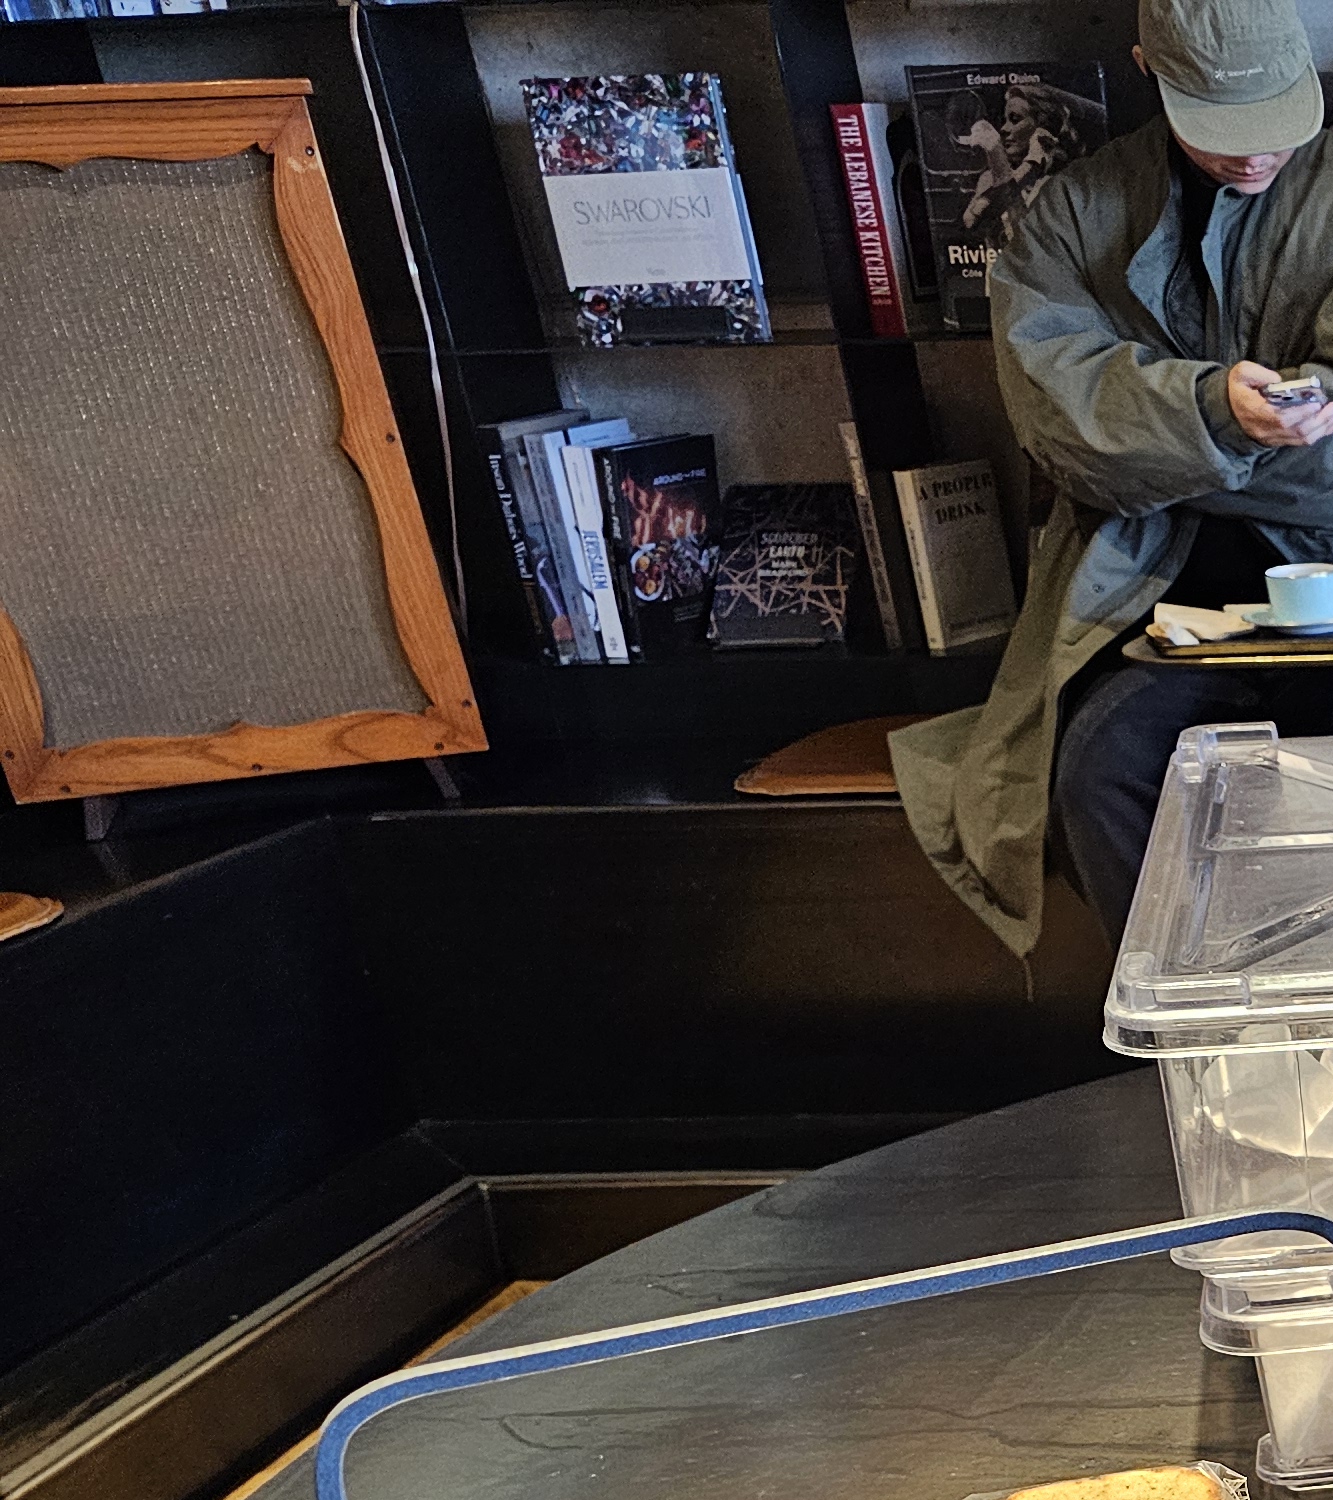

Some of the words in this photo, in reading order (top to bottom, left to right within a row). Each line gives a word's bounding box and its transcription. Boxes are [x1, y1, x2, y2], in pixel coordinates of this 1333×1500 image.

[967, 74, 1006, 85] Edward
[838, 115, 862, 146] THE
[844, 153, 878, 228] LEBANESE
[573, 195, 711, 225] SWAROVSKI
[859, 232, 891, 296] KITCHEN
